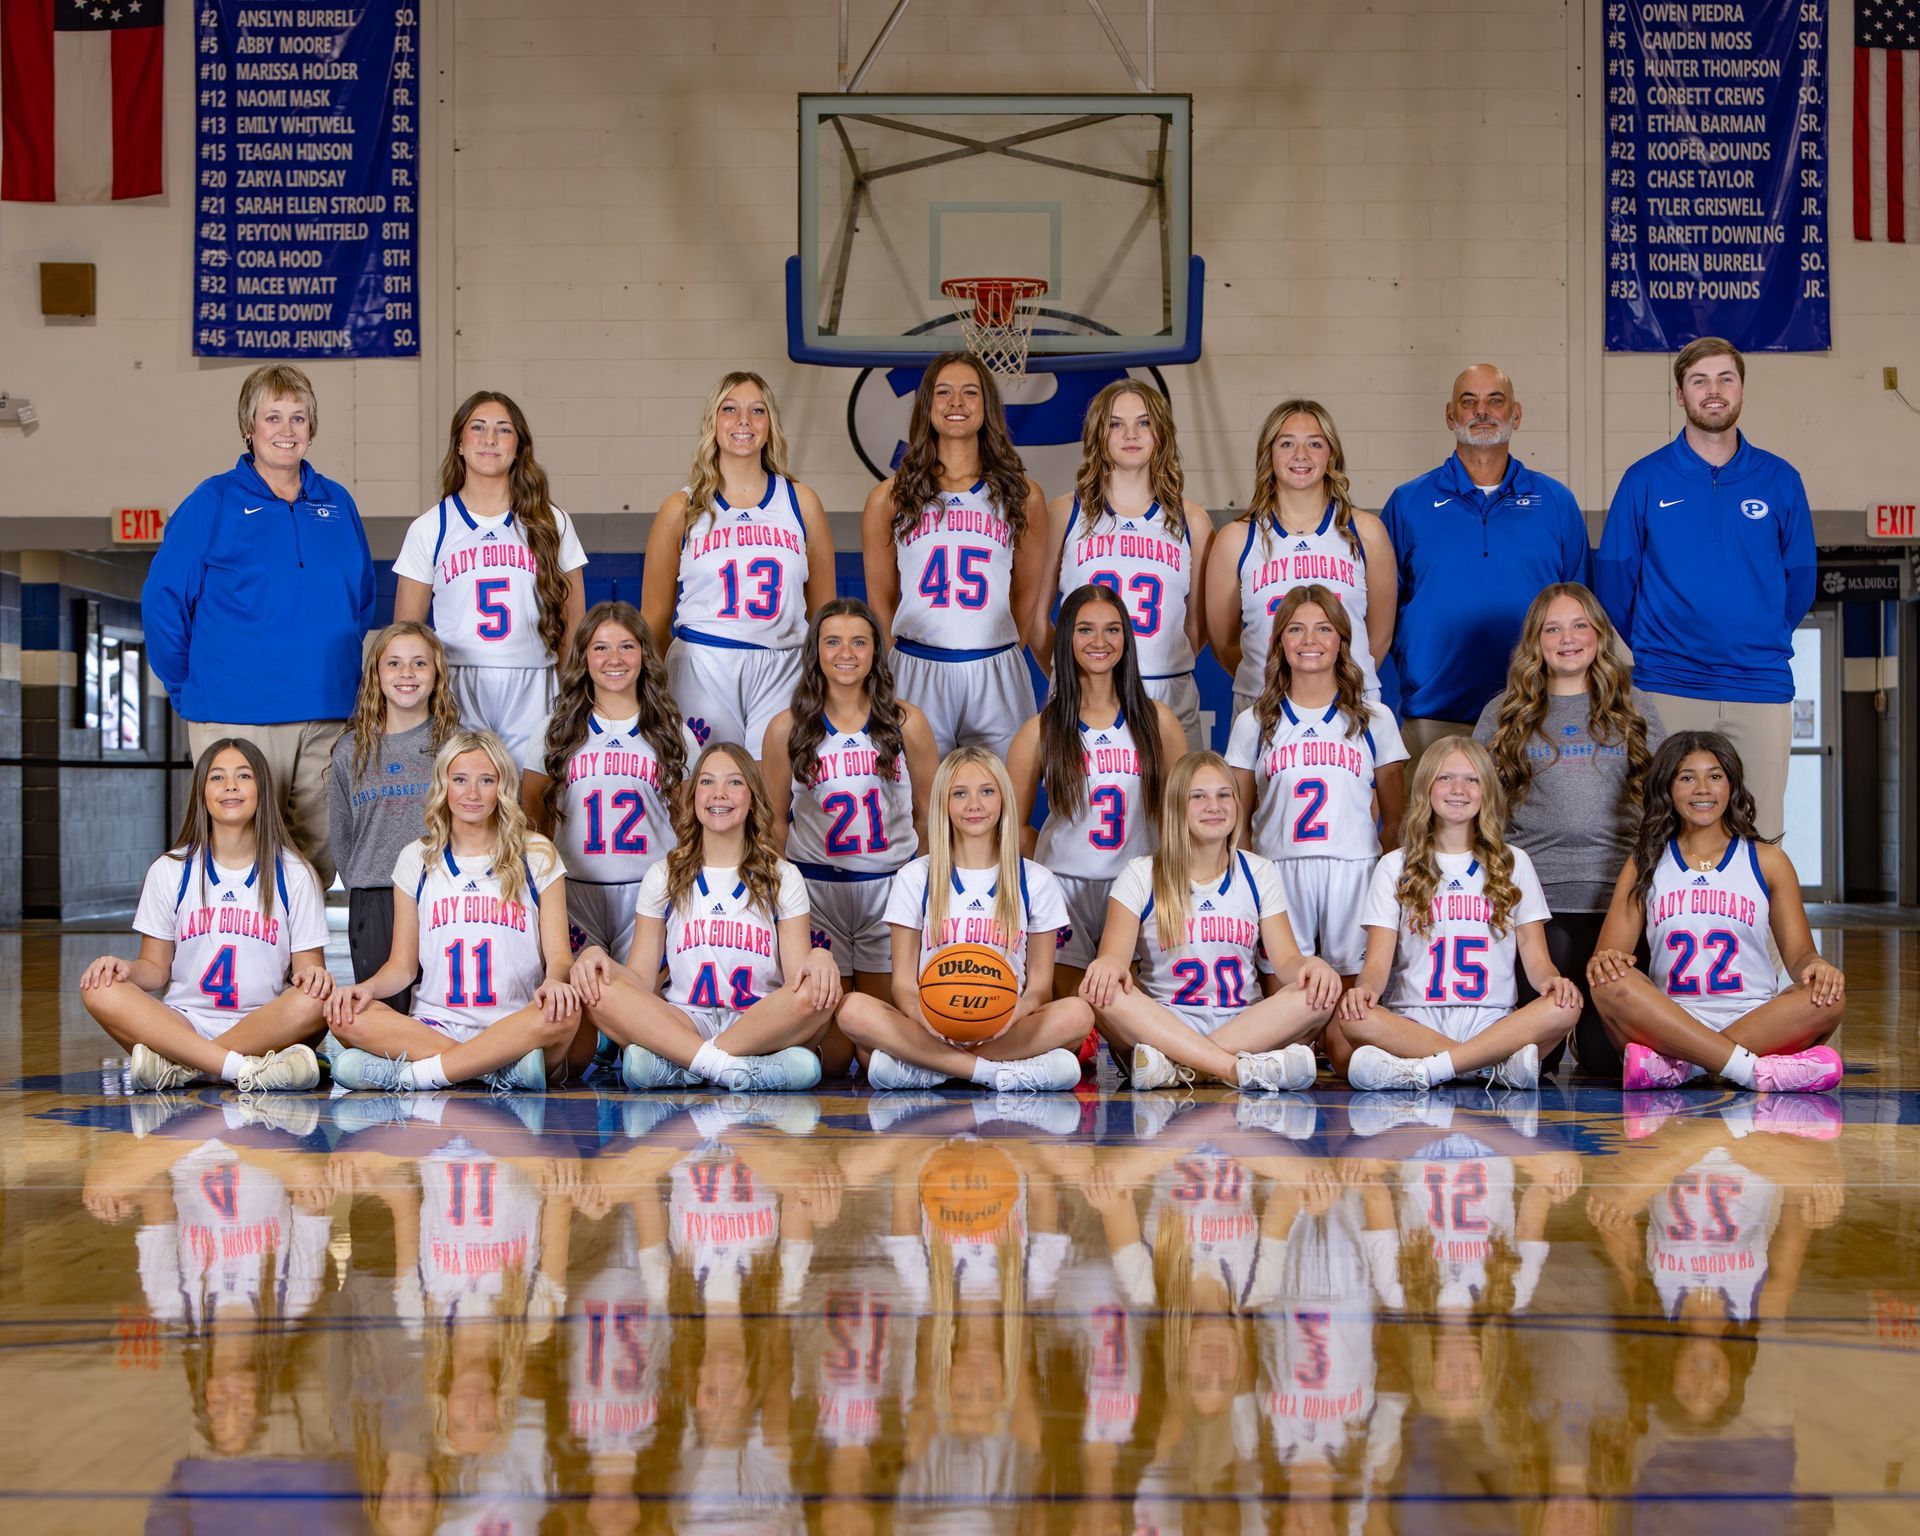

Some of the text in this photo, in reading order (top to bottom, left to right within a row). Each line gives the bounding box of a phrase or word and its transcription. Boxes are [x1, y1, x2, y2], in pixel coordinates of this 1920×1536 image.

[200, 9, 417, 27] #2 ANSLYN BURRELL SO.
[1608, 4, 1822, 22] #2 OWEN PIEDRA SR.
[200, 35, 415, 54] #5 ABBY MOORE FR.
[1608, 31, 1822, 49] #5 CAMDEN MOSS SO.
[200, 62, 415, 81] #10 MARISSA HOLDER SR.
[1609, 59, 1821, 78] #15 HUNTER THOMPSON JR.
[200, 88, 413, 107] #12 NAOMI MASK FR.
[1609, 87, 1822, 105] #20 CORBETT CREWS SO.
[200, 115, 413, 134] #13 EMILY WHITWELL SR.
[1610, 114, 1821, 133] #21 ETHAN BARMAN SR.
[200, 142, 413, 161] #15 TEAGAN HINSON SR.
[1610, 142, 1822, 161] #22 KOOPER POUNDS FR.
[201, 169, 413, 188] #20 ZARYA LINDSAY FR.
[1611, 169, 1822, 188] #23 CHASE TAYLOR SR.
[201, 195, 414, 215] #21 SARAH ELLEN STROUD FR.
[1611, 197, 1822, 216] #24 TYLER GRISWELL JR.
[201, 223, 410, 241] #22 PEYTON WHITFIELD 8TH
[1611, 225, 1823, 244] #25 BARRETT DOWNING JR.
[200, 249, 411, 268] #25 CORA HOOD 8TH
[1610, 253, 1825, 272] #31 KOHEN BURRELL SO.
[200, 276, 412, 294] #32 MACEE WYATT 8TH
[1610, 280, 1825, 299] #32 KOLBY POUNDS JR.
[199, 302, 412, 321] #34 LACIE DOWDY 8TH
[199, 329, 416, 348] #45 TAYLOR JENKINS SO.
[121, 509, 160, 540] EXIT
[947, 510, 1009, 548] COUGARS
[1877, 505, 1916, 535] EXIT
[693, 525, 801, 561] LADY COUGARS
[1077, 534, 1181, 572] LADY COUGARS
[442, 544, 541, 585] LADY COUGAR
[918, 545, 993, 611] 45
[1253, 554, 1355, 594] LADY COUGARS
[717, 556, 784, 621] 13
[475, 577, 512, 641] 5
[565, 751, 600, 790] ADY
[1095, 748, 1142, 777] COUGA
[1264, 741, 1363, 783] LADY COUGARS
[583, 789, 648, 855] 12
[822, 788, 889, 857] 21
[1088, 784, 1126, 851] 3
[1293, 777, 1329, 843] 2
[429, 895, 527, 933] ADY COUGARS
[1448, 894, 1491, 926] COUGA
[1652, 888, 1756, 928] LADY COUGARS
[180, 906, 280, 946] LADY COUGARS
[709, 919, 771, 957] COUGARS
[965, 917, 1024, 955] COUGAS
[444, 938, 497, 1008] 11
[938, 959, 1002, 981] Wilson
[1424, 936, 1489, 1002] 15
[1665, 928, 1744, 996] 22
[199, 944, 239, 1010] 4
[1170, 955, 1248, 1008] 20
[949, 994, 989, 1009] EVO
